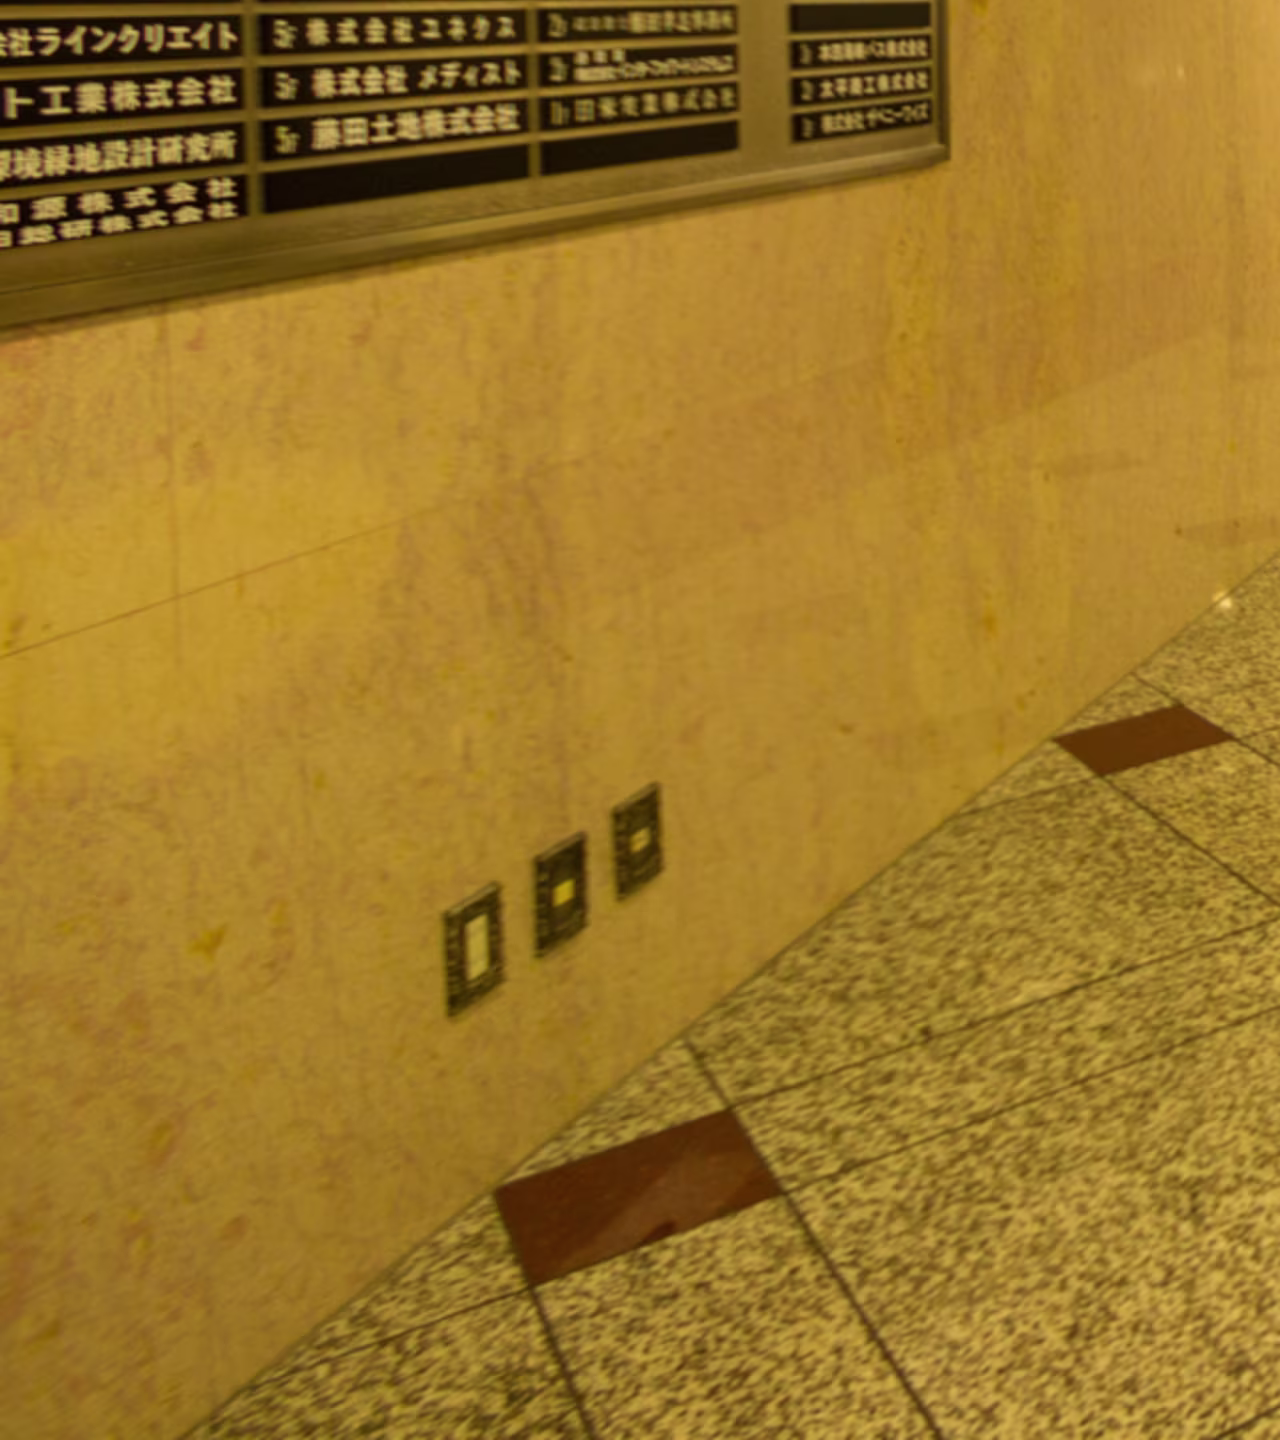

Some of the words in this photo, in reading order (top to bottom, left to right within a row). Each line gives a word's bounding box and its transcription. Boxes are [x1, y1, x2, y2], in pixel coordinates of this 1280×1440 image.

[306, 16, 515, 46] 株式会社ユネクス
[312, 64, 409, 98] 株式会社
[418, 59, 521, 91] メディスト
